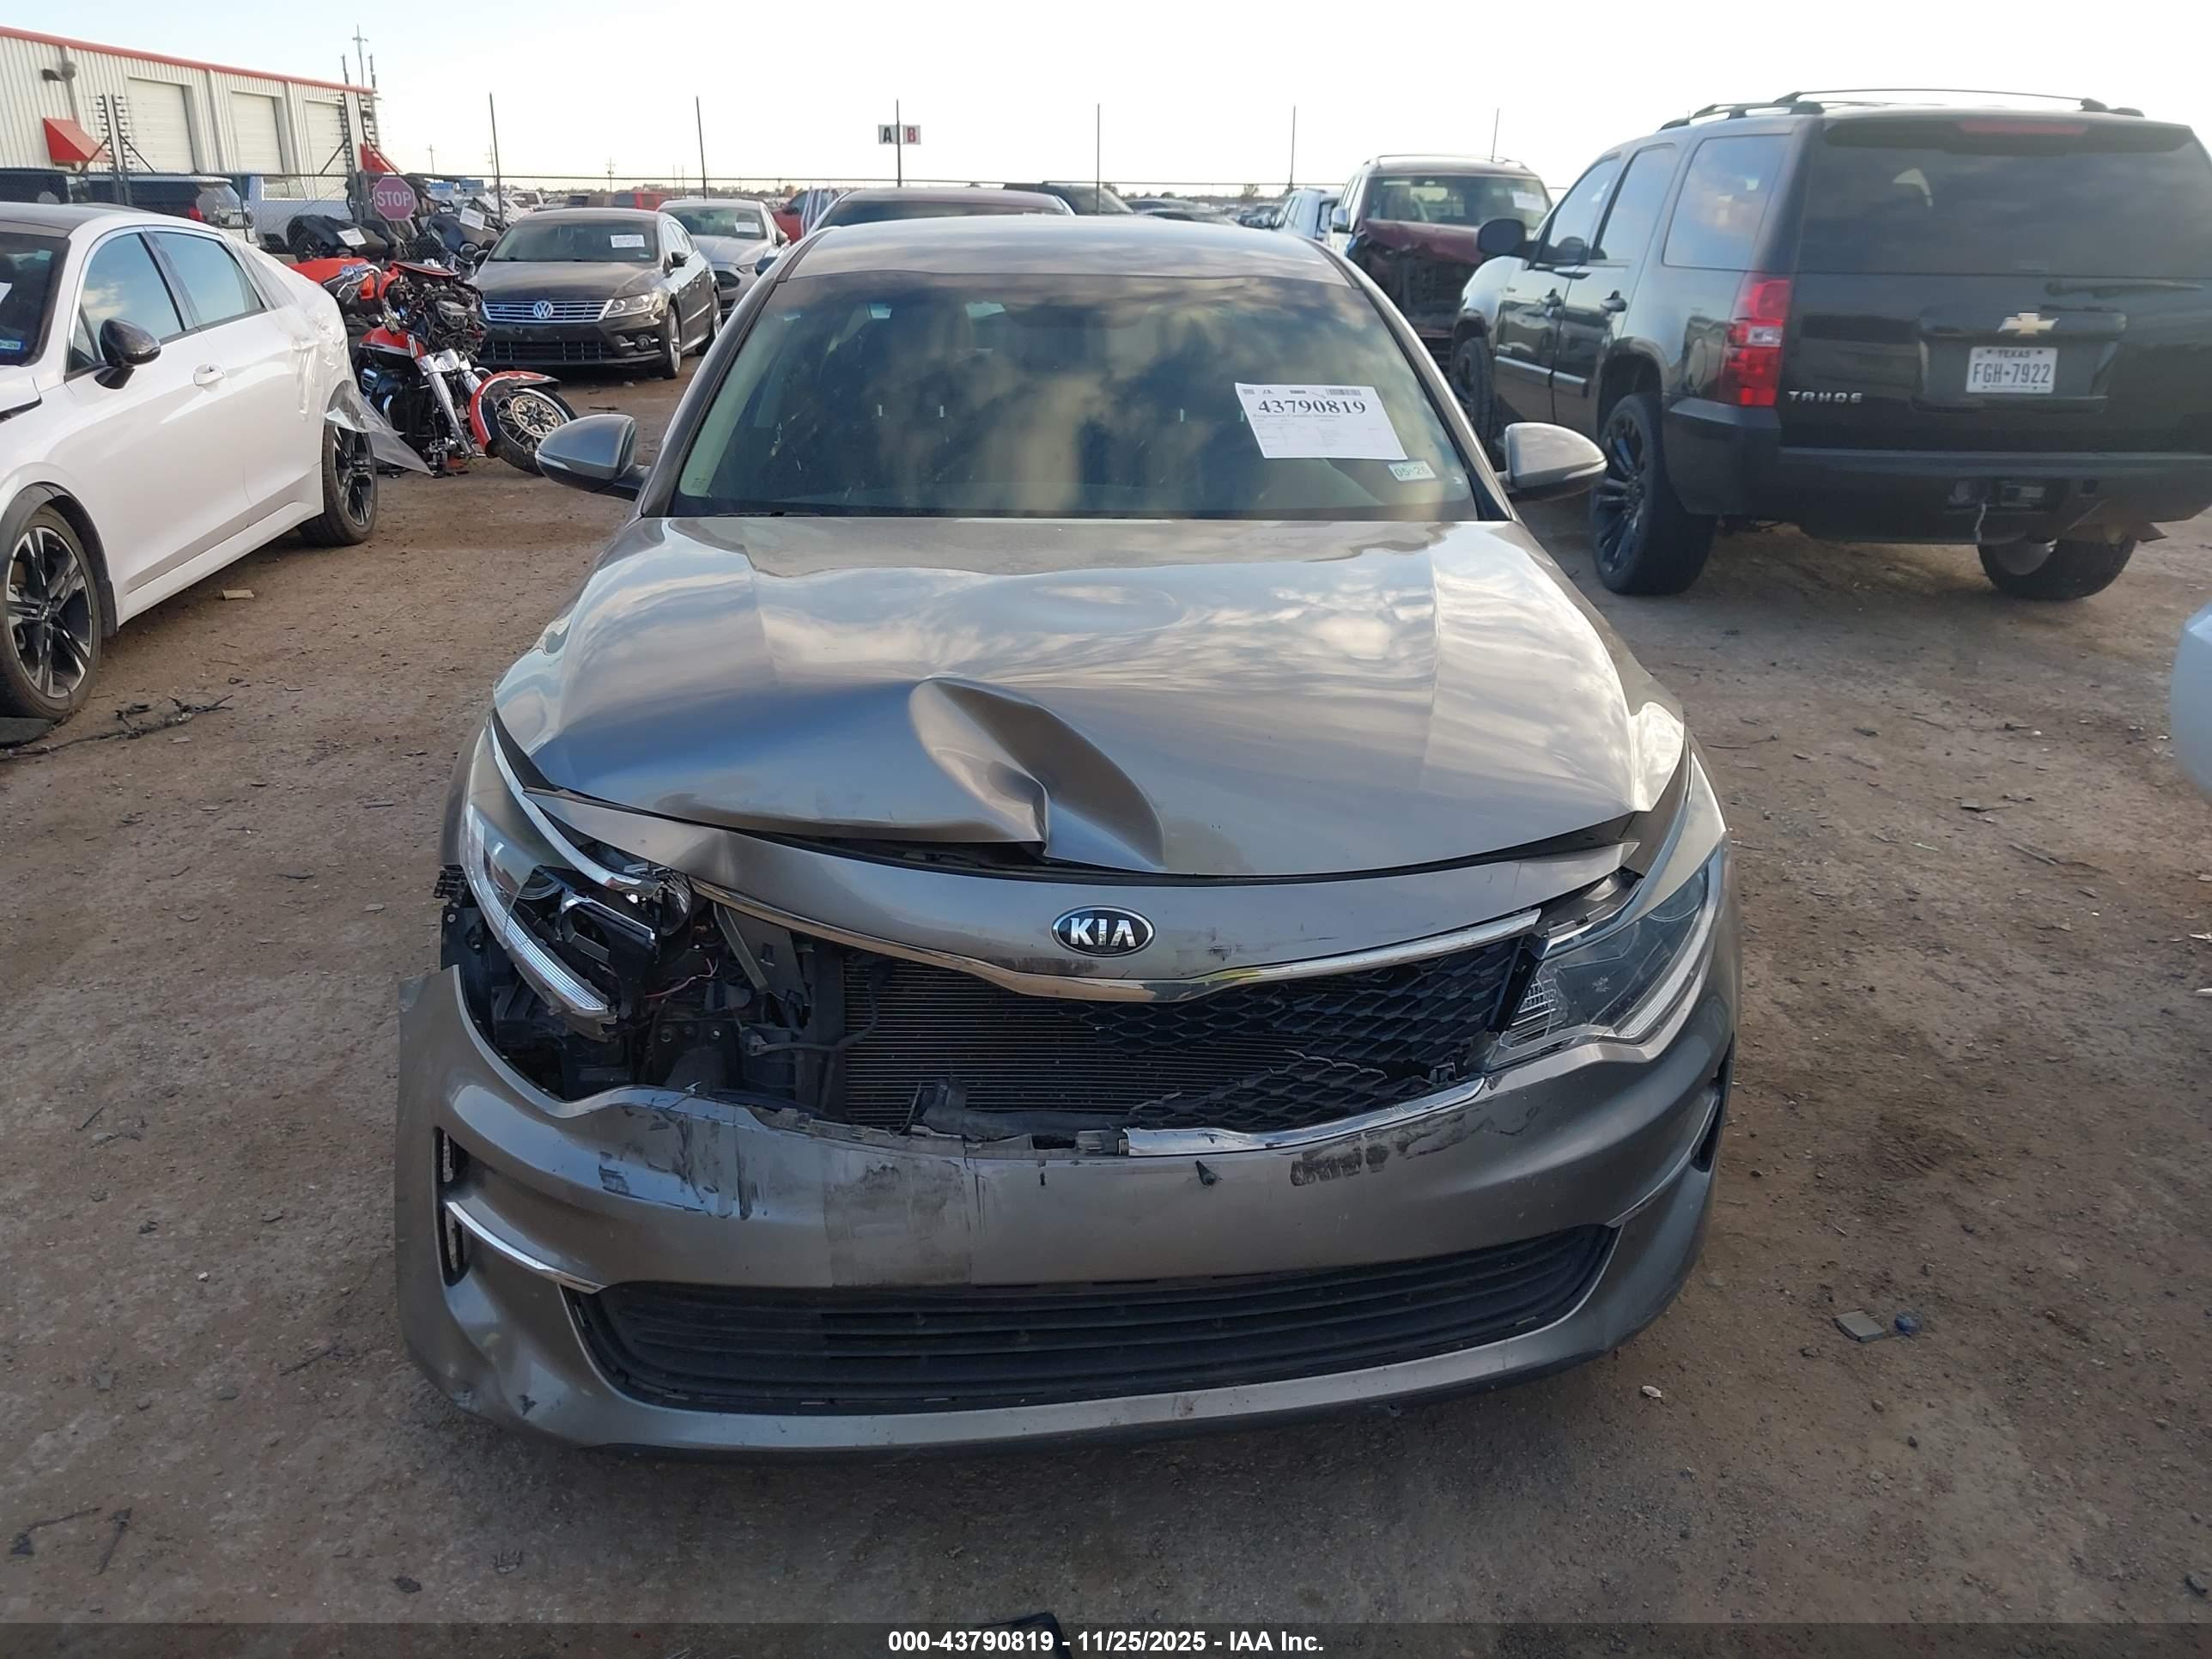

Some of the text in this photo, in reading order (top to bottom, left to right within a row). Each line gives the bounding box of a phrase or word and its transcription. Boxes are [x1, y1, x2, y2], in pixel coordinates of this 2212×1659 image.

[883, 126, 893, 143] A
[907, 126, 917, 143] B
[376, 191, 412, 207] STOP
[1998, 349, 2031, 358] TEXAS
[1789, 391, 1862, 403] TAHOE
[1258, 399, 1366, 414] 43790819
[1070, 917, 1137, 947] KIA
